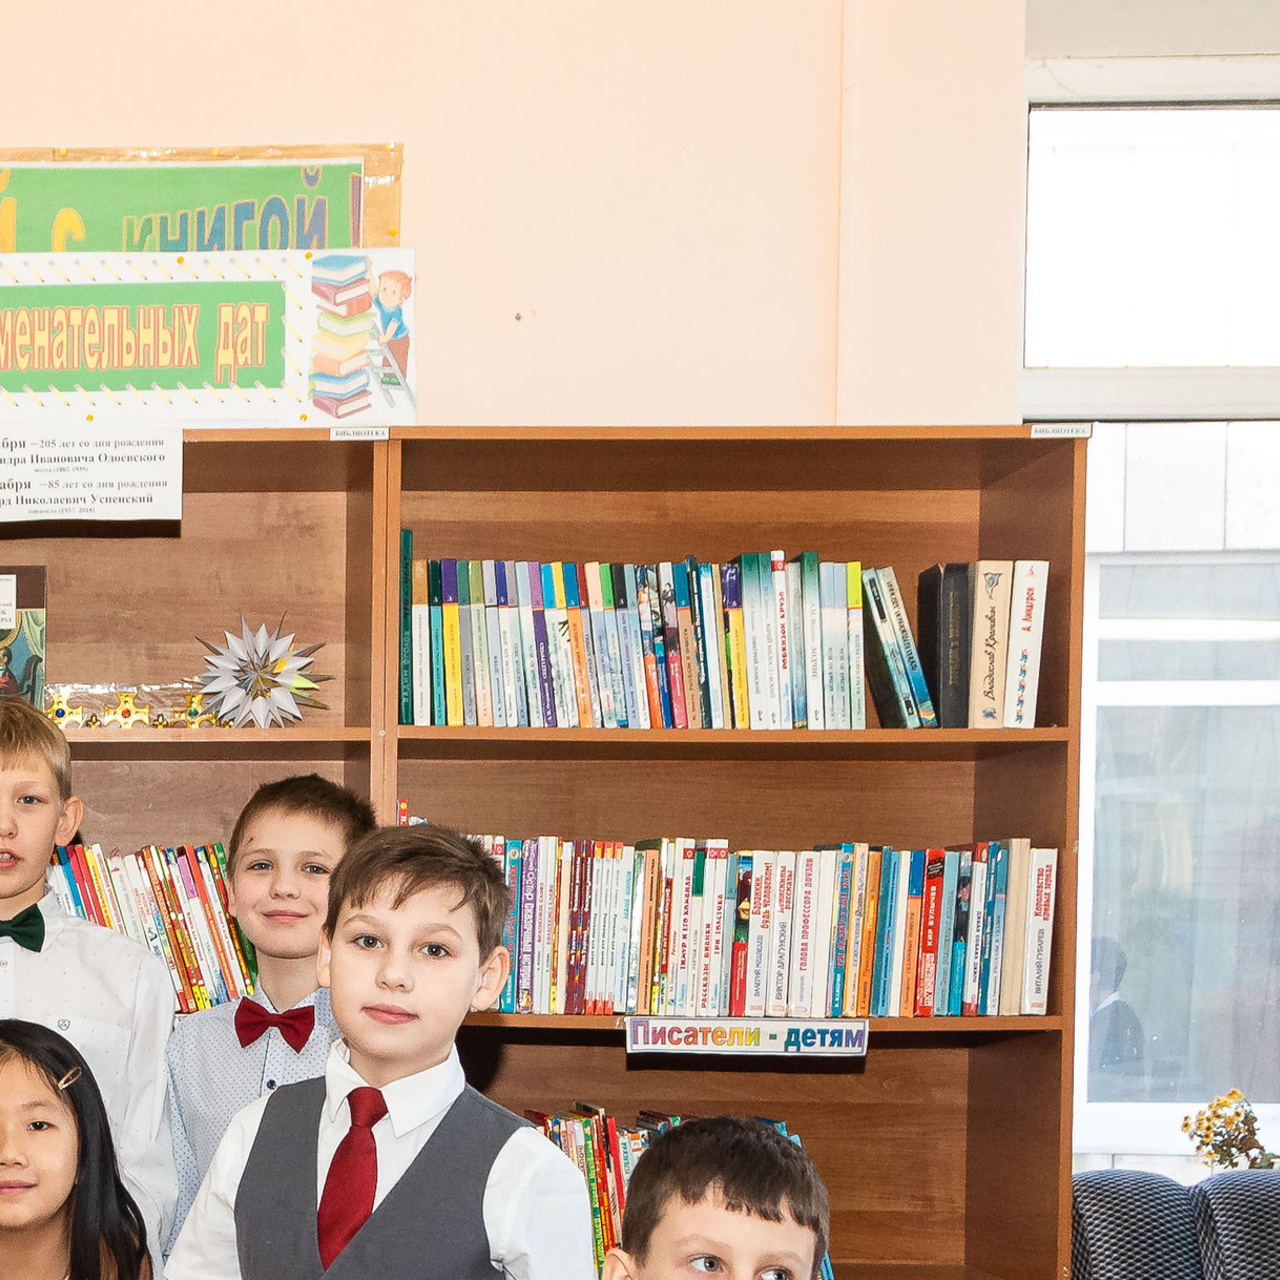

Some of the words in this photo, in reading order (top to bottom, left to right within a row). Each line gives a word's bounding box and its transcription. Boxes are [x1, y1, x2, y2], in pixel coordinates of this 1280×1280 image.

[215, 302, 269, 385] дат
[30, 454, 94, 464] Ивановича
[98, 453, 165, 463] Одоевского
[59, 440, 75, 448] лет
[114, 439, 165, 450] рождения
[16, 495, 86, 505] Николаевич
[91, 494, 153, 505] Успенский
[62, 480, 79, 488] лет
[118, 480, 167, 491] рождения
[1021, 587, 1036, 622] Линдгрен
[983, 605, 998, 650] Крапивин
[780, 623, 788, 669] РОБИНЗОН
[983, 650, 996, 701] Владислав
[760, 862, 773, 908] человеком!
[804, 858, 813, 888] ДОУЭЛЯ
[1044, 864, 1053, 889] зеркал
[683, 875, 691, 915] КОМАНДА
[752, 875, 763, 915] Баранкин,
[928, 885, 937, 926] БУЛЫЧЕВ
[1033, 867, 1044, 917] Королевство
[1042, 892, 1051, 921] кривых
[758, 910, 769, 929] будь
[801, 890, 811, 940] ПРОФЕССОРА
[755, 935, 763, 968] МЕДВЕДЕВ
[776, 921, 787, 969] ДРАГУНСКИЙ
[799, 942, 808, 971] ГОЛОВА
[1036, 928, 1045, 960] ГУБАРЕВ
[701, 963, 709, 1008] РАССКАЗЫ
[754, 969, 762, 997] ВАЛЕРИЙ
[775, 970, 784, 1000] ВИКТОР
[1034, 961, 1043, 994] ВИТАЛИЙ
[632, 1020, 761, 1047] Писатели
[784, 1027, 864, 1052] детям
